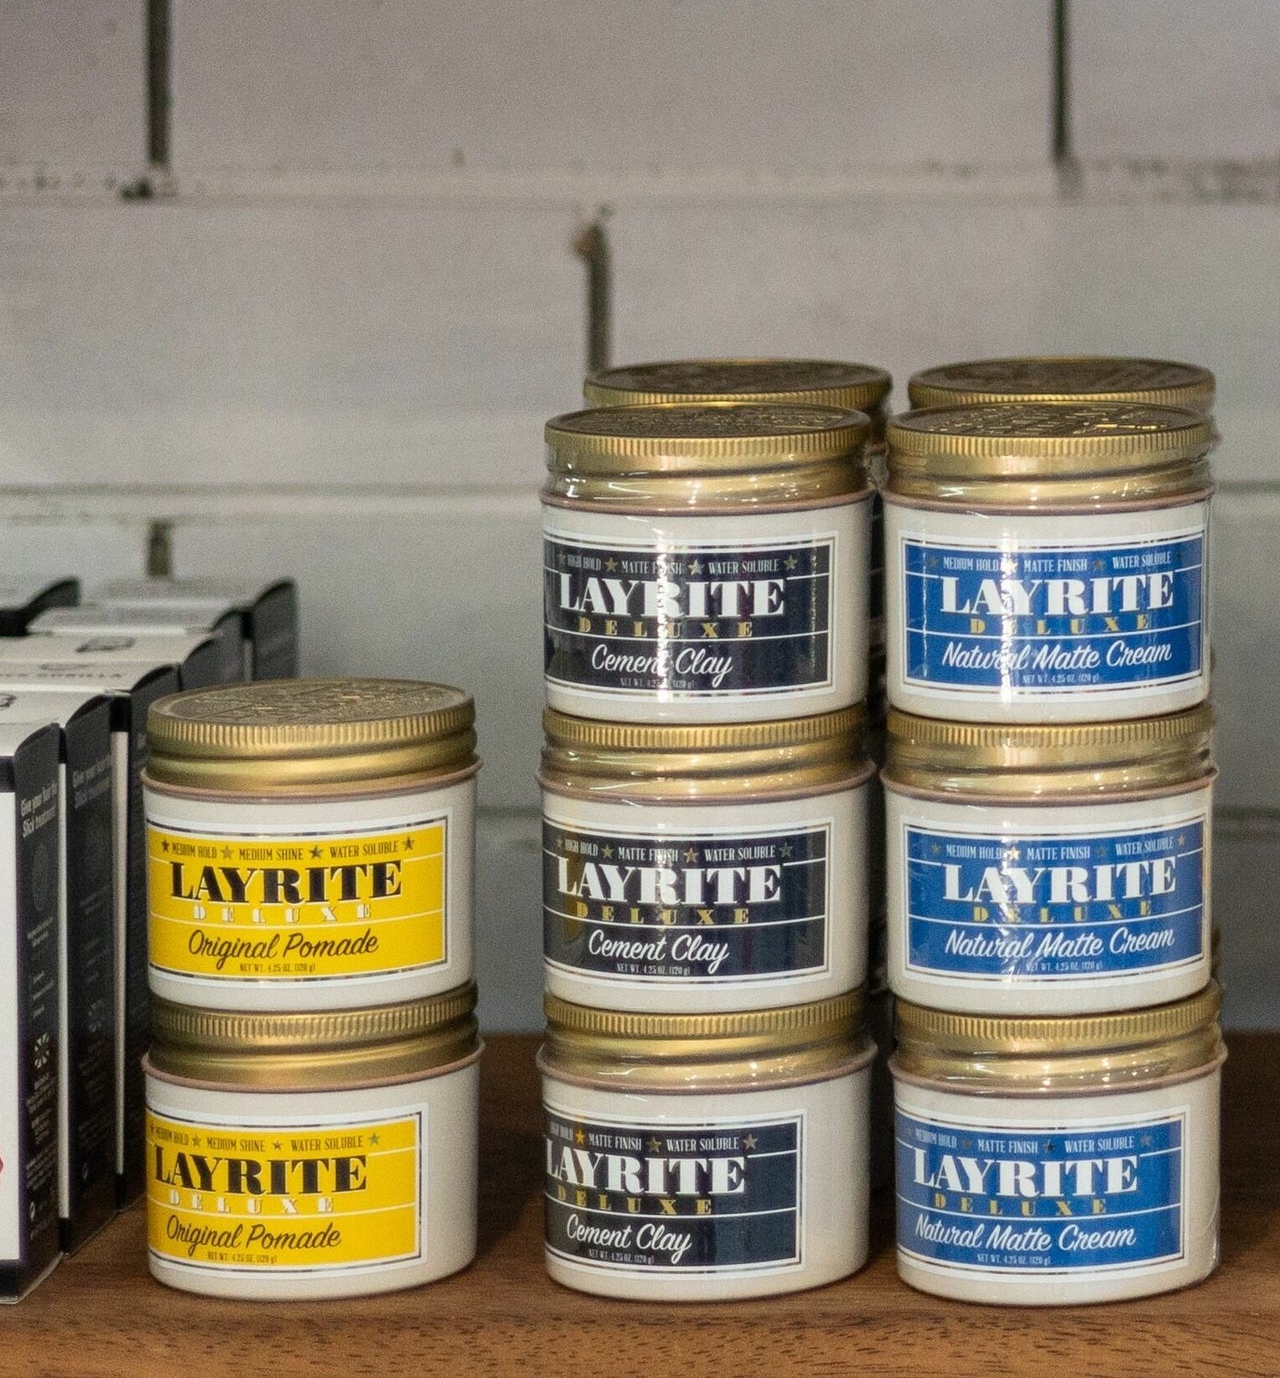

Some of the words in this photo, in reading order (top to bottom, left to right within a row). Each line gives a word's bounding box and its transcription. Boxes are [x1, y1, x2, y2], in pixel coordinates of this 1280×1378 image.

[560, 573, 785, 618] LAYRITE
[940, 571, 1175, 616] LAYRITE
[592, 644, 669, 673] Cement
[676, 647, 733, 687] Clay
[942, 642, 1031, 670] Natural
[1033, 645, 1100, 670] Matte
[1106, 640, 1172, 668] Cream
[239, 848, 273, 861] MEDIUM
[276, 848, 304, 860] SHINE
[170, 860, 402, 904] LAYRITE
[558, 857, 781, 905] LAYRITE
[942, 856, 1176, 903] LAYRITE
[189, 929, 280, 969] Original
[282, 928, 379, 958] Pomade
[589, 929, 666, 960] Cement
[672, 934, 729, 974] Clay
[945, 930, 1033, 958] Natural
[1036, 932, 1103, 958] Matte
[1110, 927, 1175, 954] Cream
[153, 1146, 367, 1195] LAYRITE
[546, 1138, 745, 1195] LAYRITE
[913, 1147, 1139, 1197] LAYRITE
